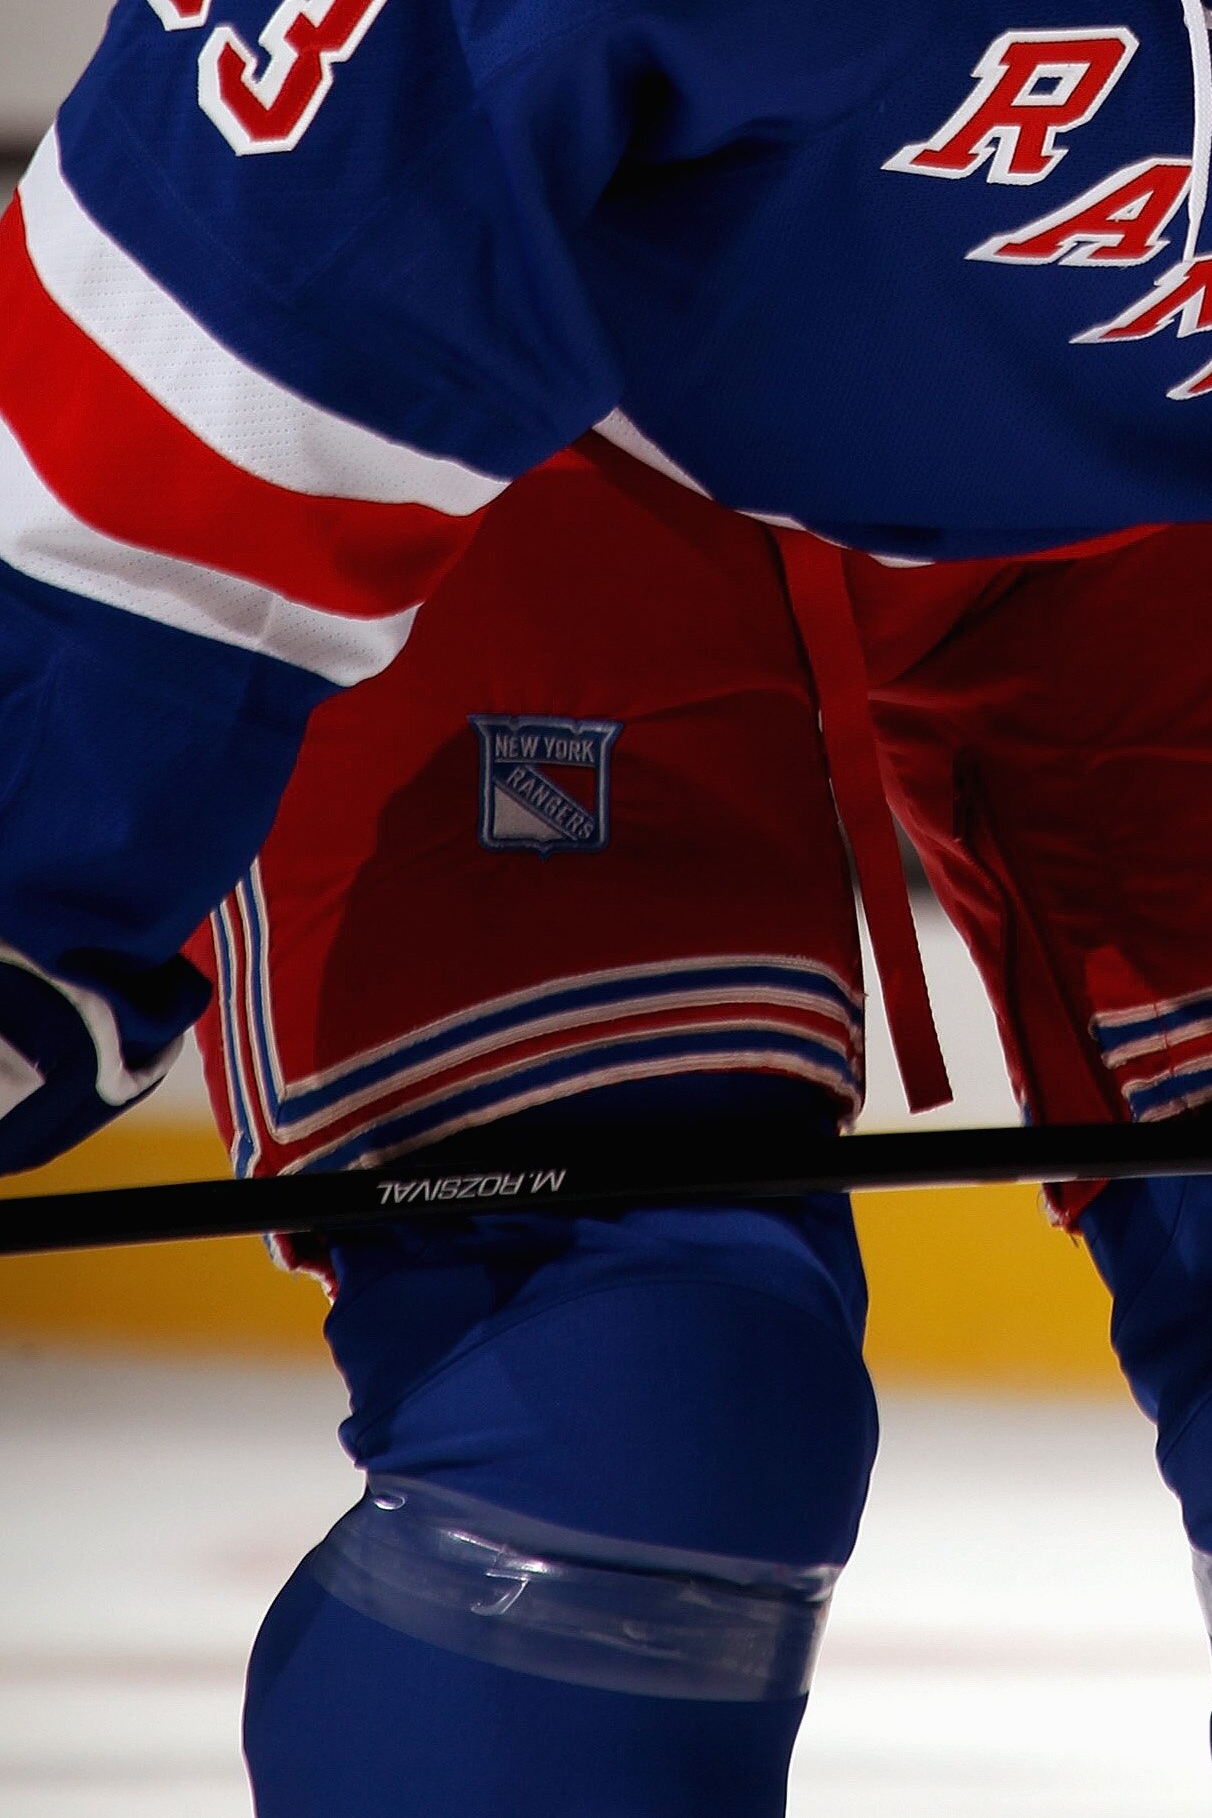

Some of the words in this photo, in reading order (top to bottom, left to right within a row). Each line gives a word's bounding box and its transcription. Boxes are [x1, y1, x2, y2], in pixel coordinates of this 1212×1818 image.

[494, 733, 539, 758] NEW
[545, 736, 595, 763] YORK
[506, 764, 595, 840] RANGERS
